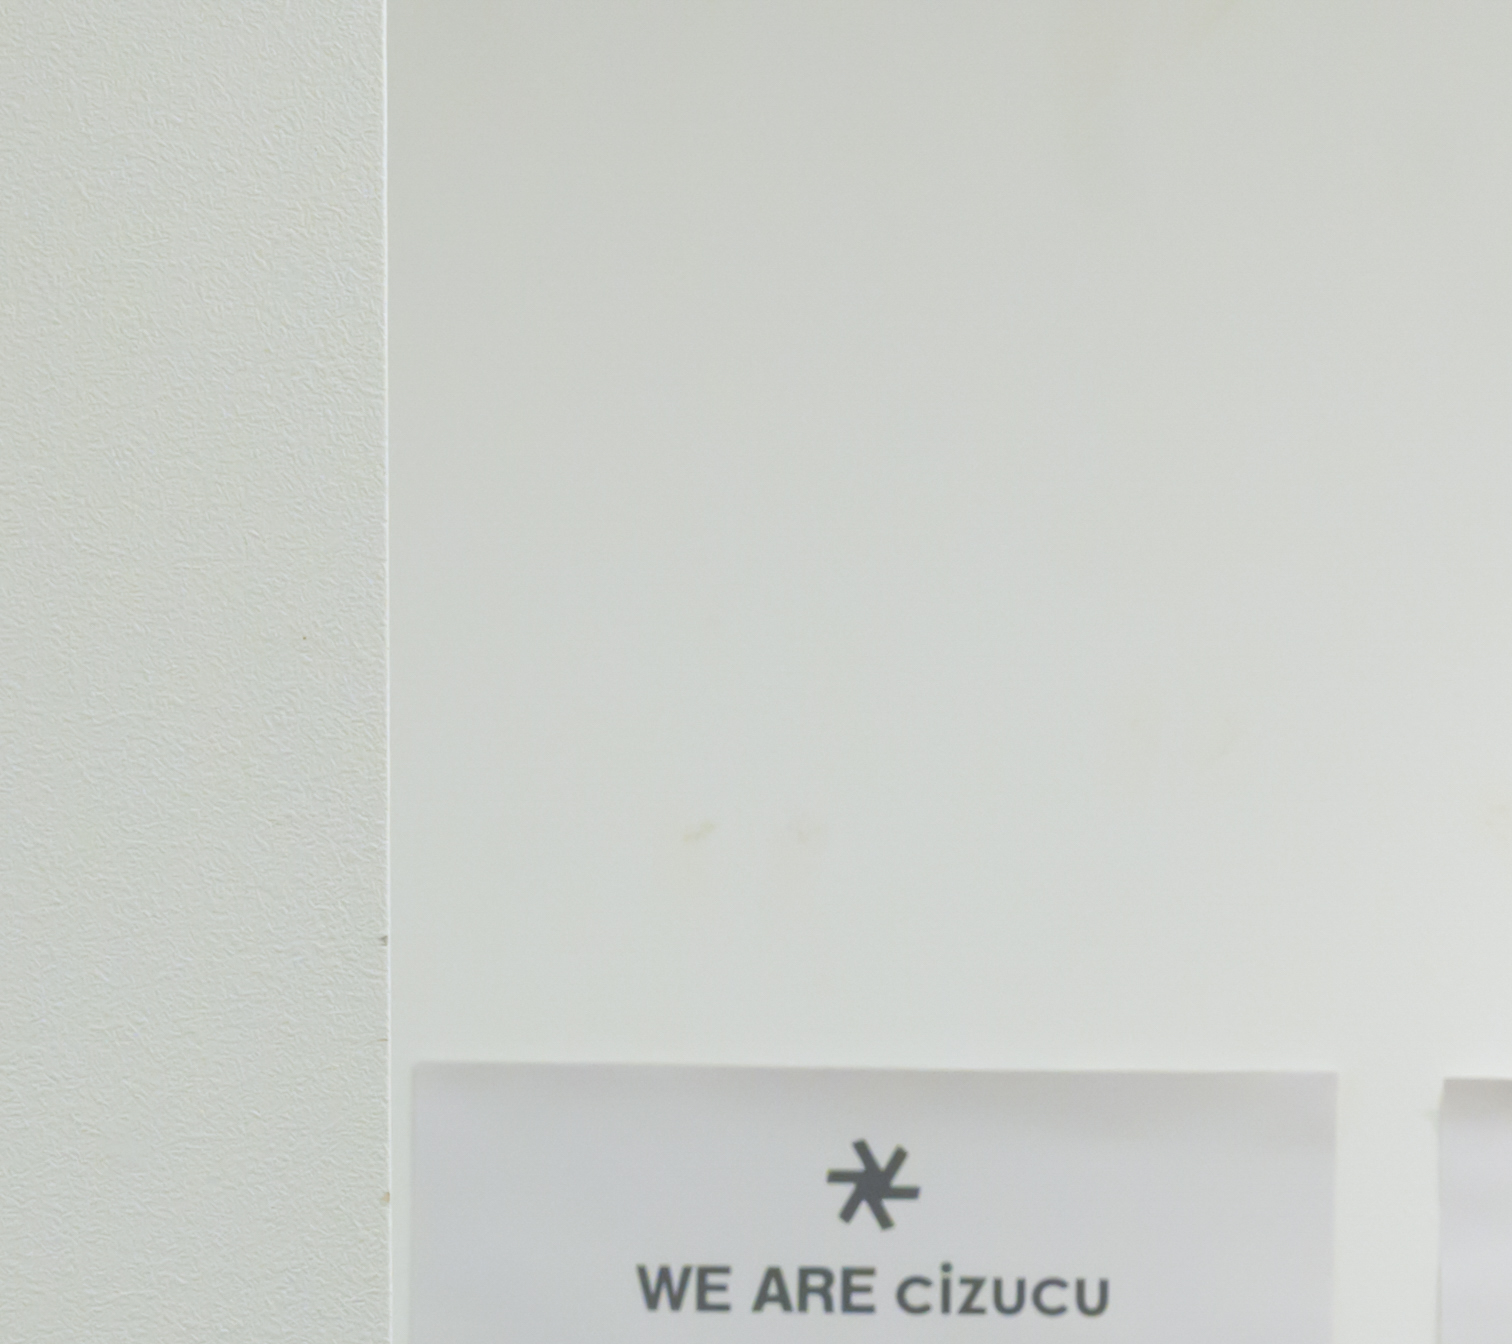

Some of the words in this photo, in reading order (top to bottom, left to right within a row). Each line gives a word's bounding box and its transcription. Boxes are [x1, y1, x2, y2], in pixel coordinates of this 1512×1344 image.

[636, 1264, 732, 1314] WE
[751, 1265, 877, 1315] ARE
[894, 1261, 1110, 1318] cizucu
